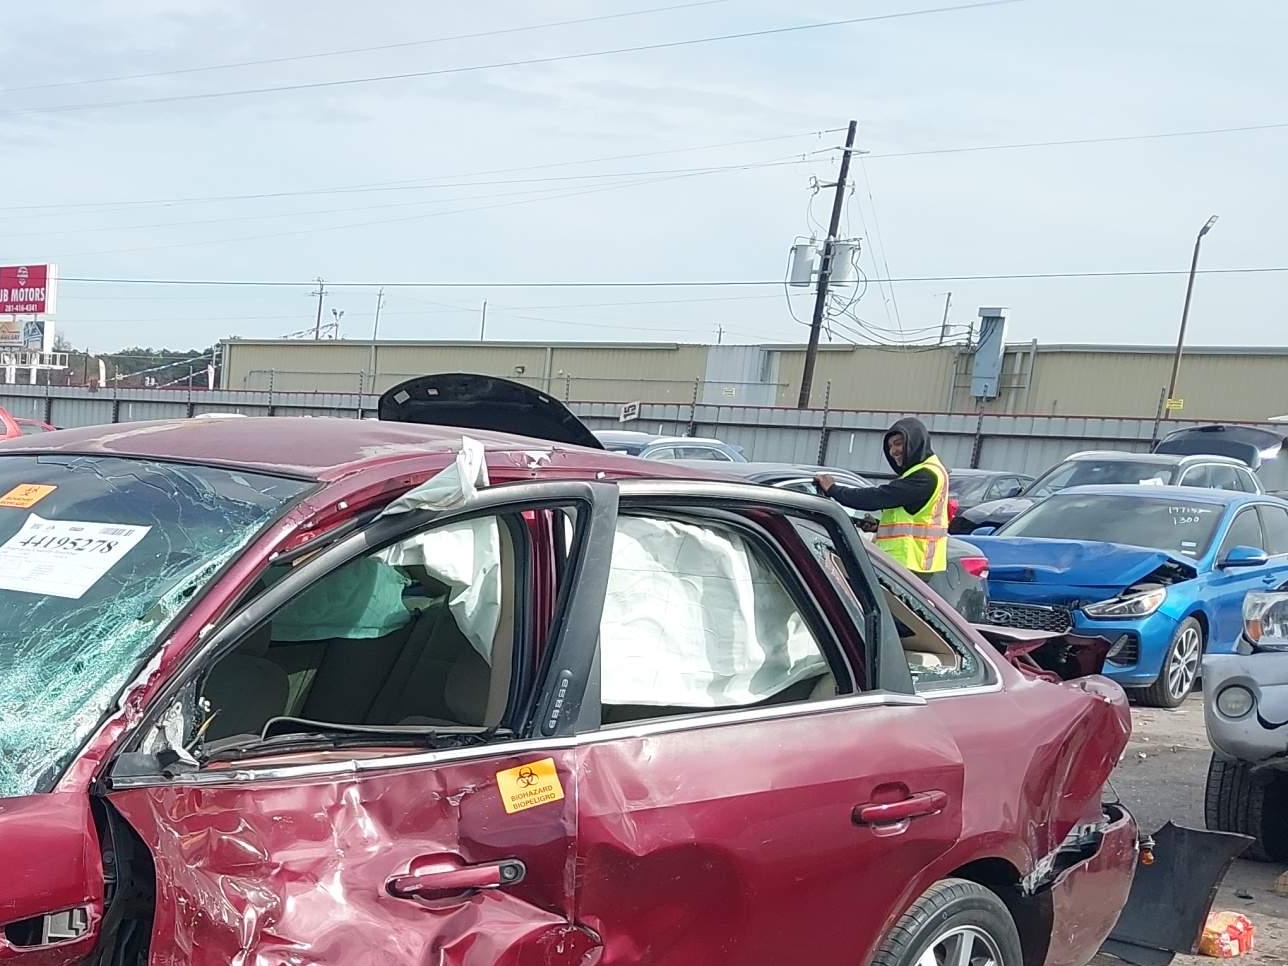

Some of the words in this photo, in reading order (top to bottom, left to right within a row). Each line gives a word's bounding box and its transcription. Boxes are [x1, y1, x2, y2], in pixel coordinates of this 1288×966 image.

[0, 288, 9, 303] JB
[10, 287, 45, 302] MOTORS
[19, 534, 120, 554] 44195278
[510, 784, 553, 802] BIOHAZARD
[513, 793, 556, 810] BIOPELIGRO
